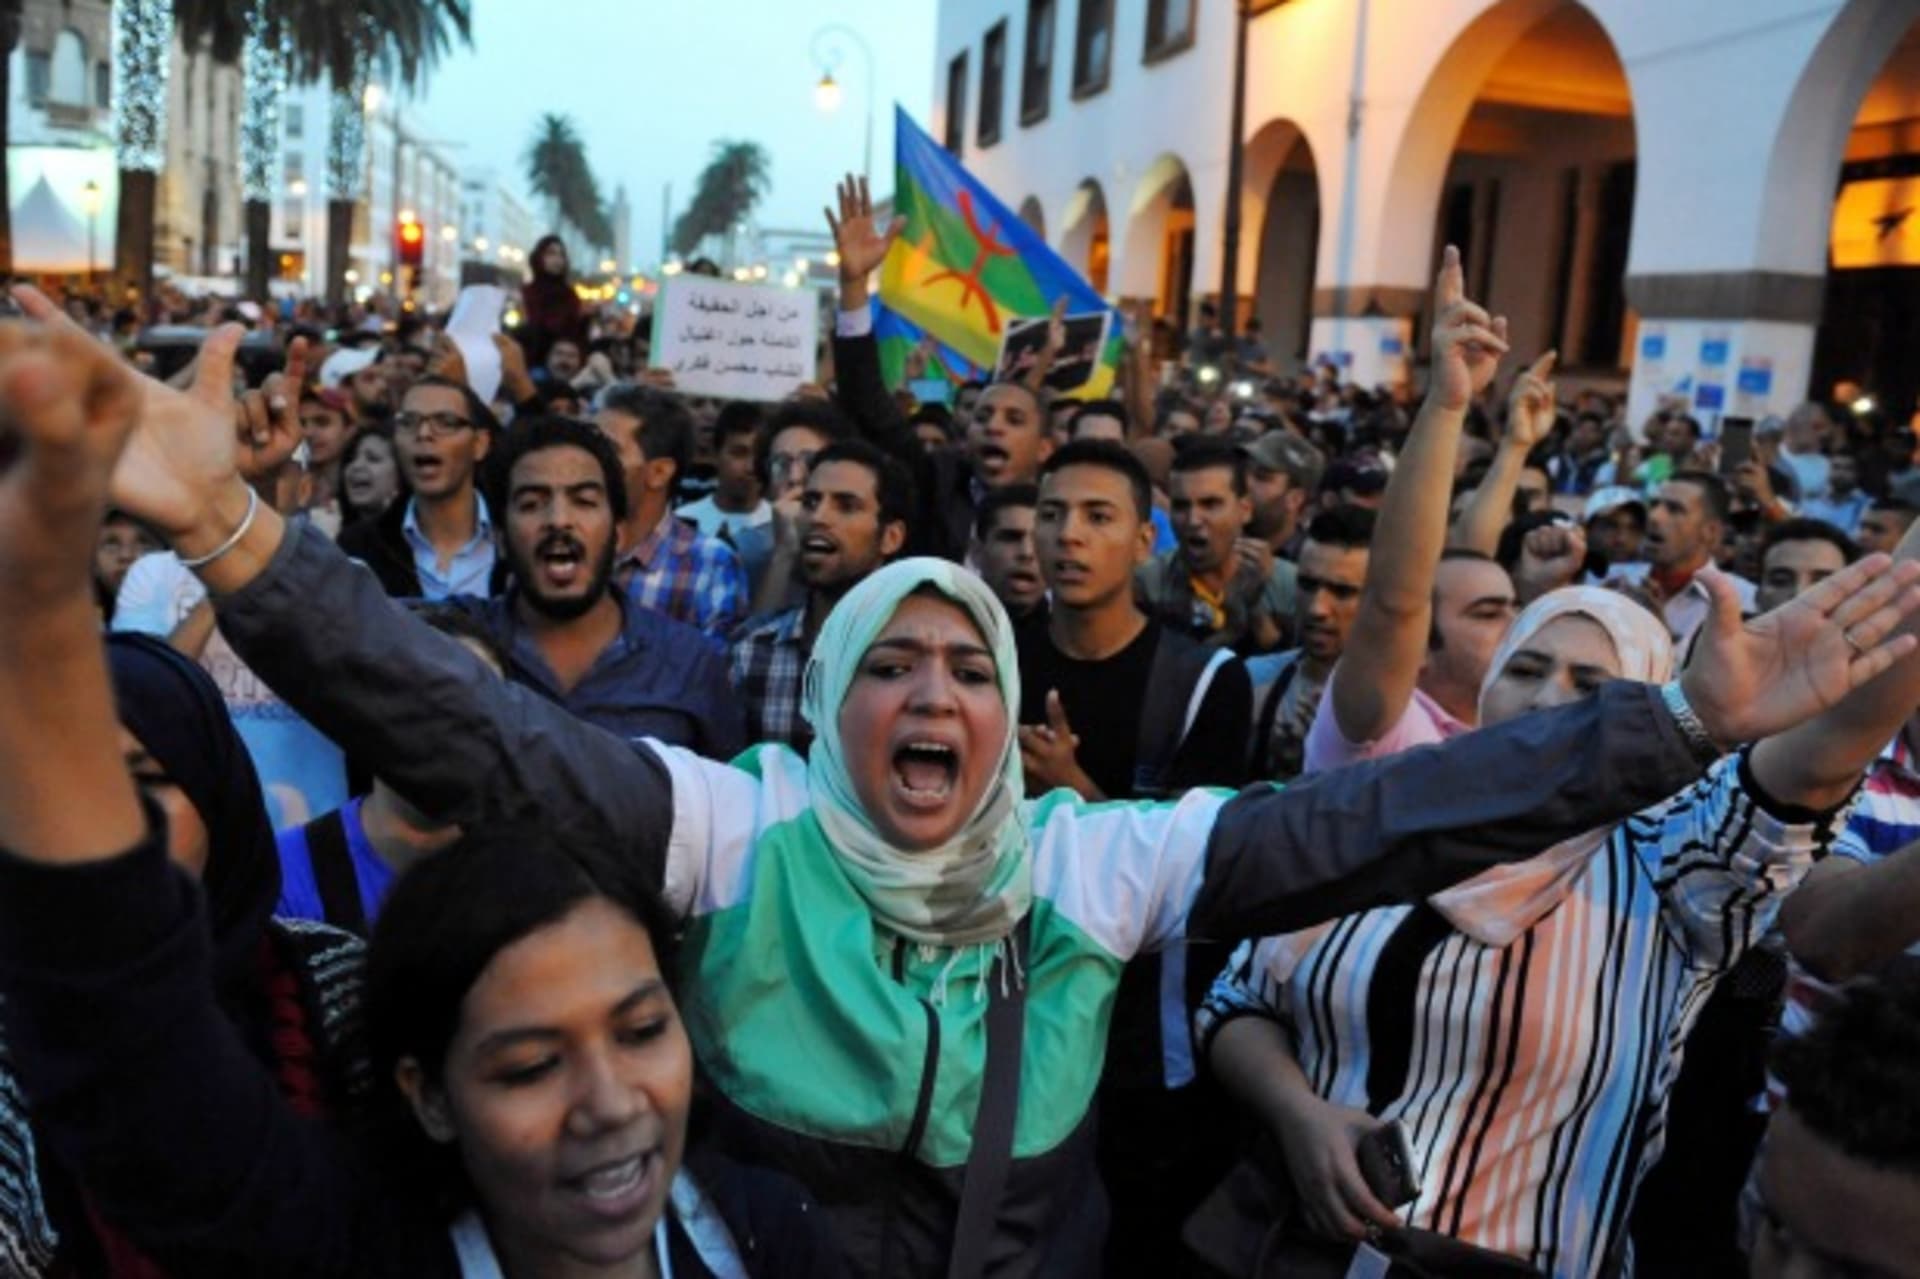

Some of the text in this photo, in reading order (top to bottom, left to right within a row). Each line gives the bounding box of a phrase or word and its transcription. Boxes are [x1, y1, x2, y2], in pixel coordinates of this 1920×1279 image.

[687, 291, 739, 313] الحقيقة
[777, 305, 798, 322] من
[727, 331, 755, 347] حول
[714, 359, 759, 375] محسن
